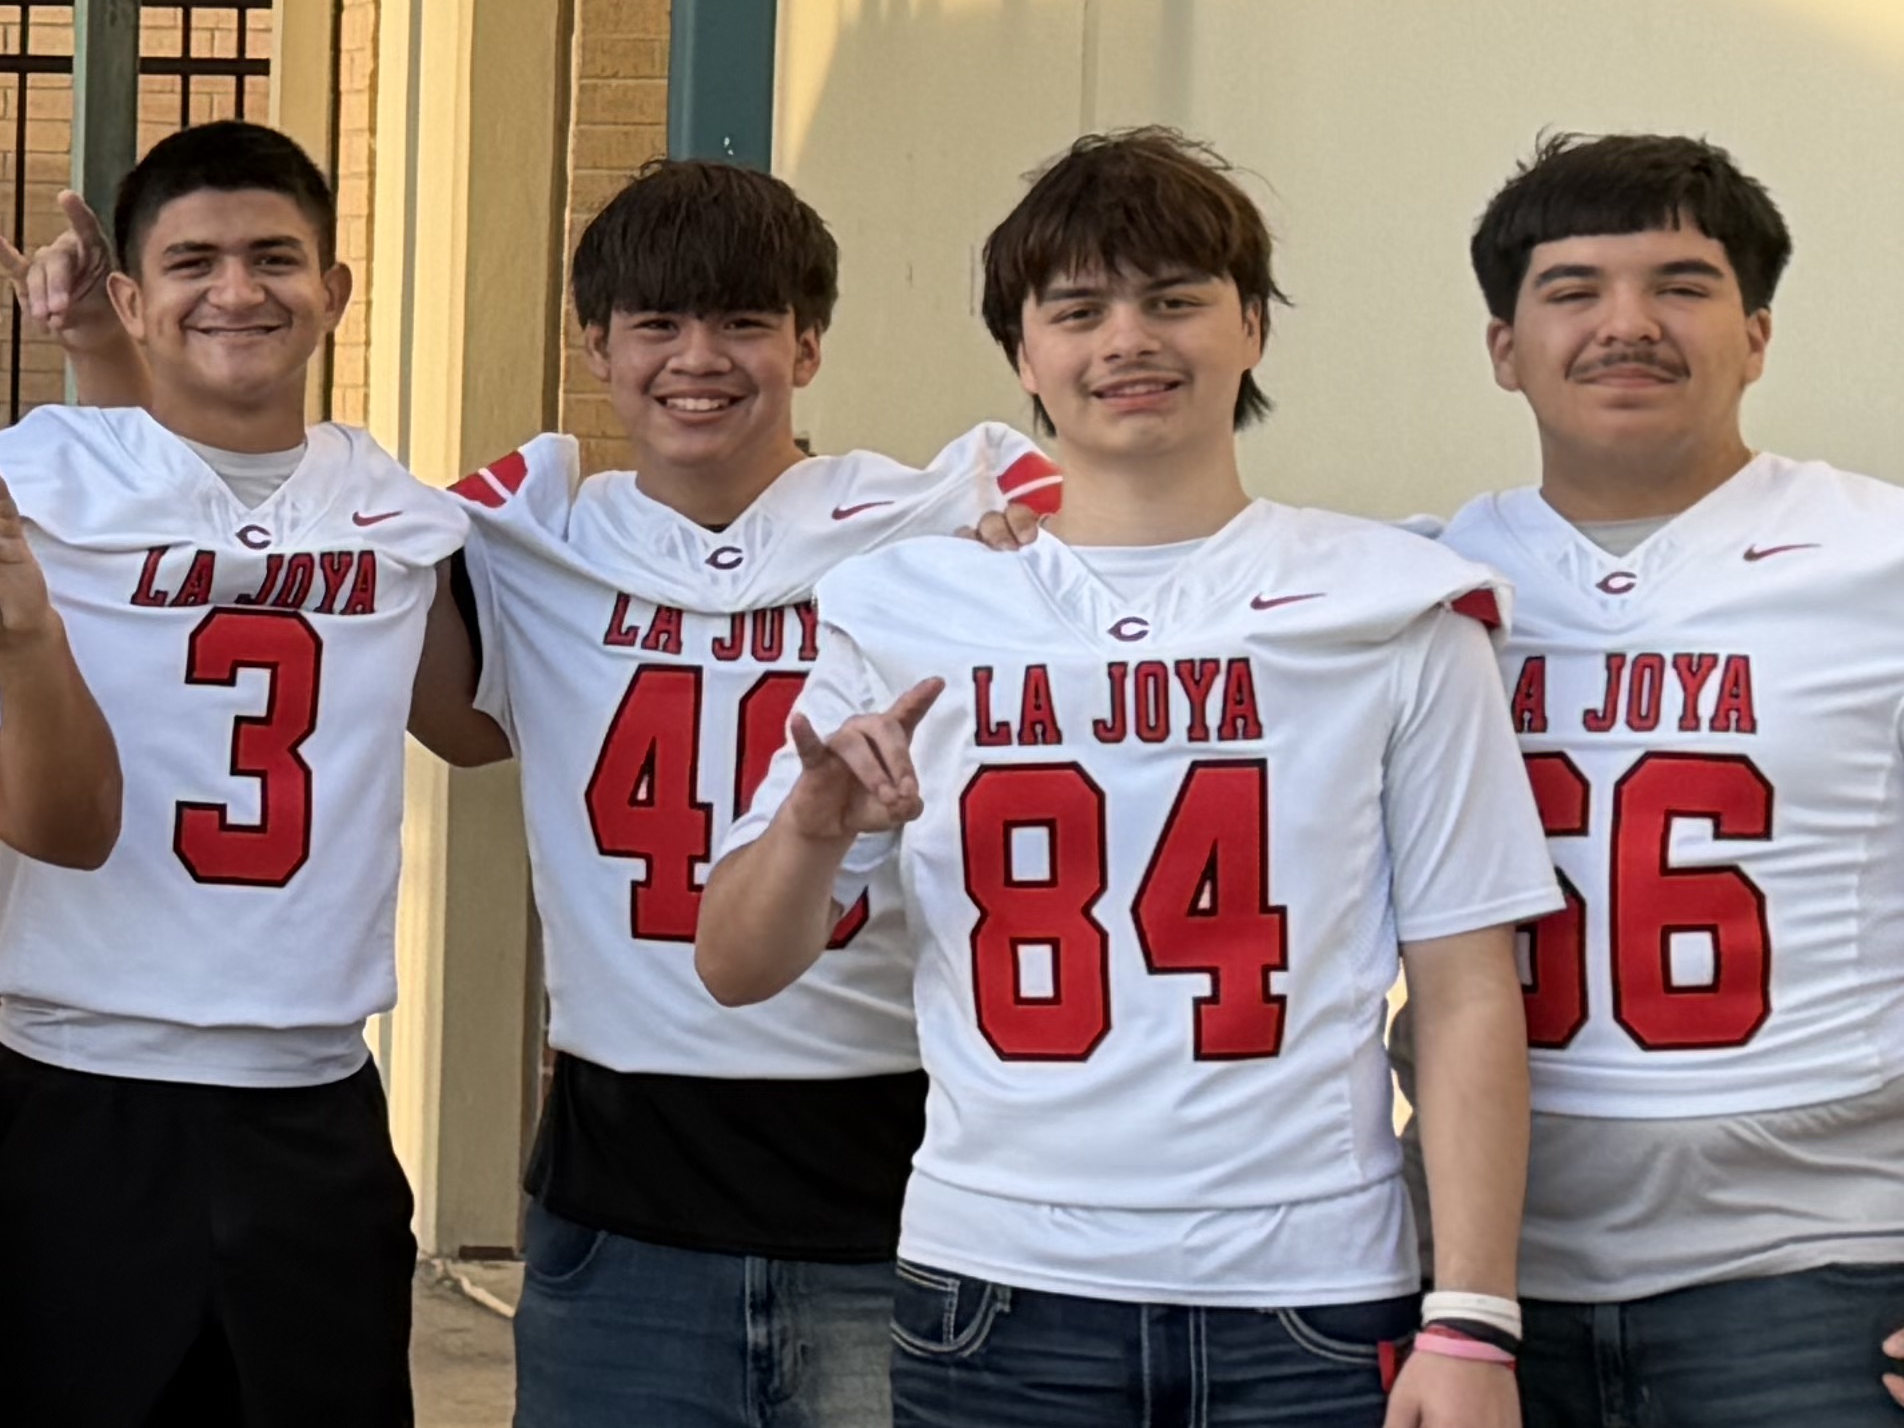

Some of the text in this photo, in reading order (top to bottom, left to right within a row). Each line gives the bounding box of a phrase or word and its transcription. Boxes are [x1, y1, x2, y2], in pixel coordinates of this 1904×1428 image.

[235, 524, 271, 550] C
[705, 546, 744, 570] C
[131, 545, 377, 615] LA JOYA
[1595, 571, 1636, 595] C
[604, 591, 818, 661] LA JOY
[1108, 617, 1148, 642] C
[972, 657, 1263, 746] LA JOYA
[1510, 652, 1757, 734] A JOYA
[173, 606, 323, 888] 3
[960, 758, 1289, 1062] 84
